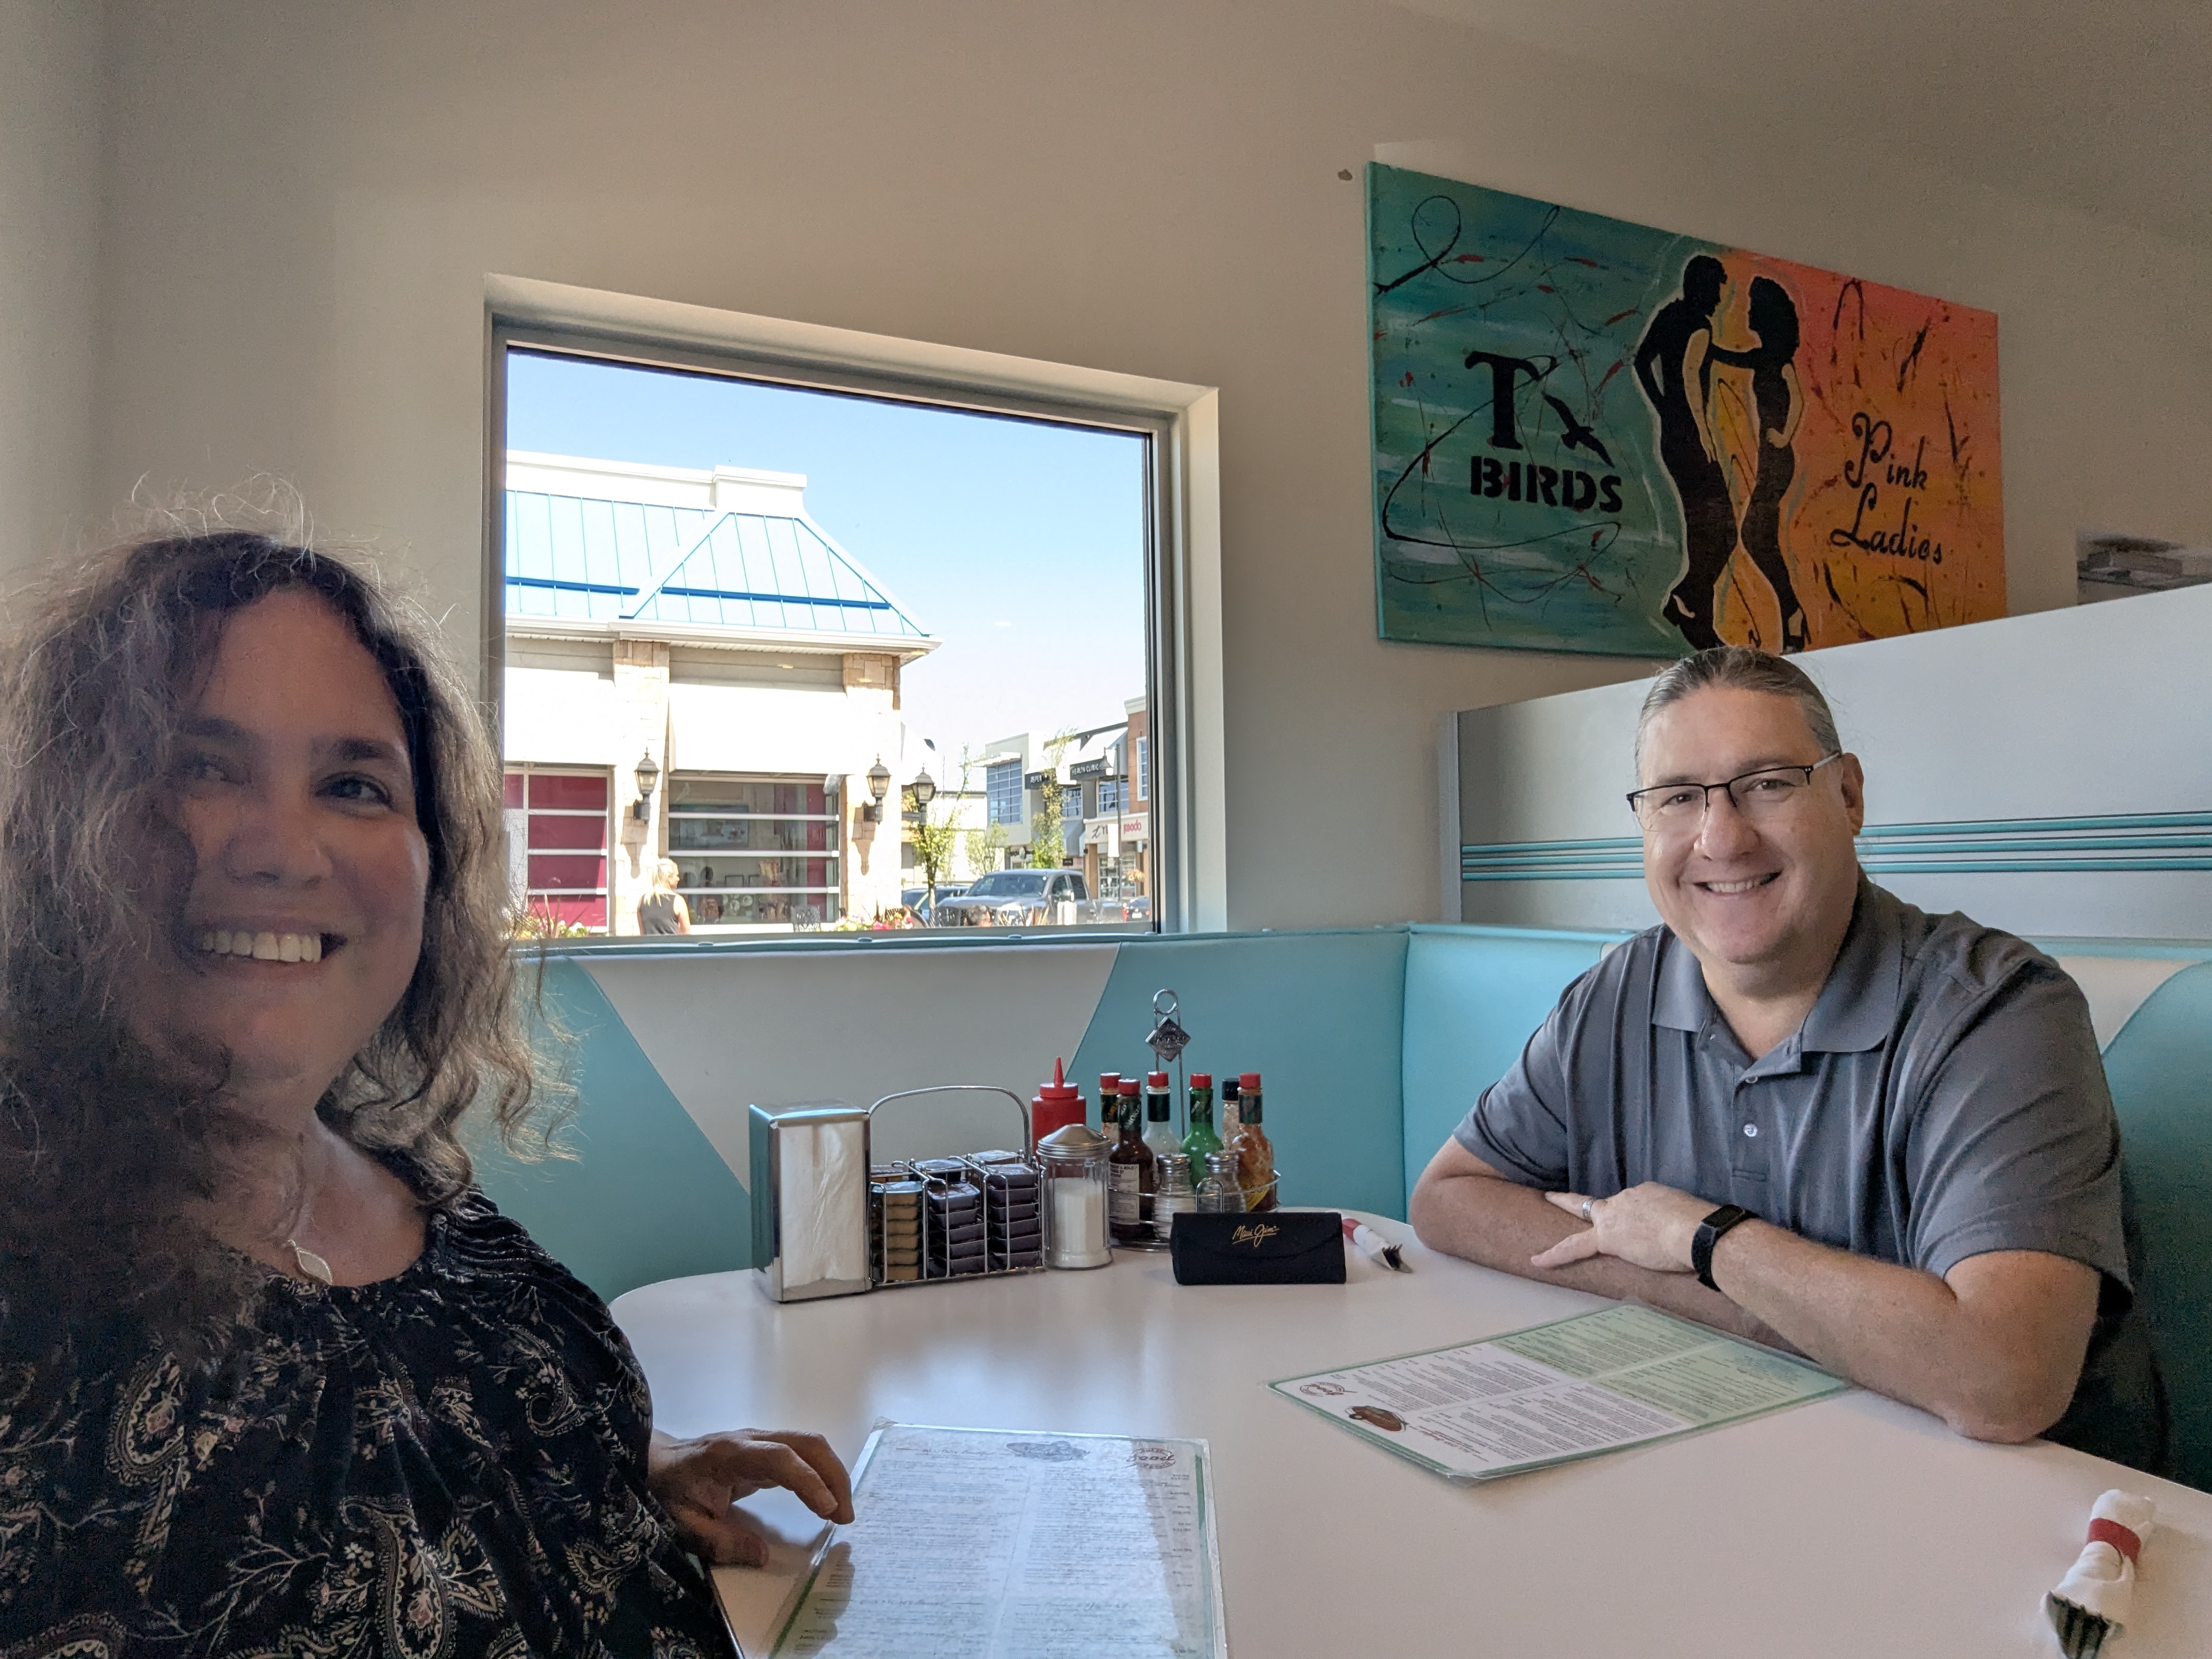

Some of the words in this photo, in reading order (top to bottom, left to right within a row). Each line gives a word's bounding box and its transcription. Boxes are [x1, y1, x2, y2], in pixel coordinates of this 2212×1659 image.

[1465, 351, 1541, 450] T
[1470, 456, 1623, 513] BIRDS
[1844, 412, 1927, 490] Pink
[1830, 482, 1942, 565] Ladies
[1072, 766, 1086, 775] HEALTH
[1232, 1225, 1253, 1240] Maui
[1253, 1223, 1281, 1248] Jim
